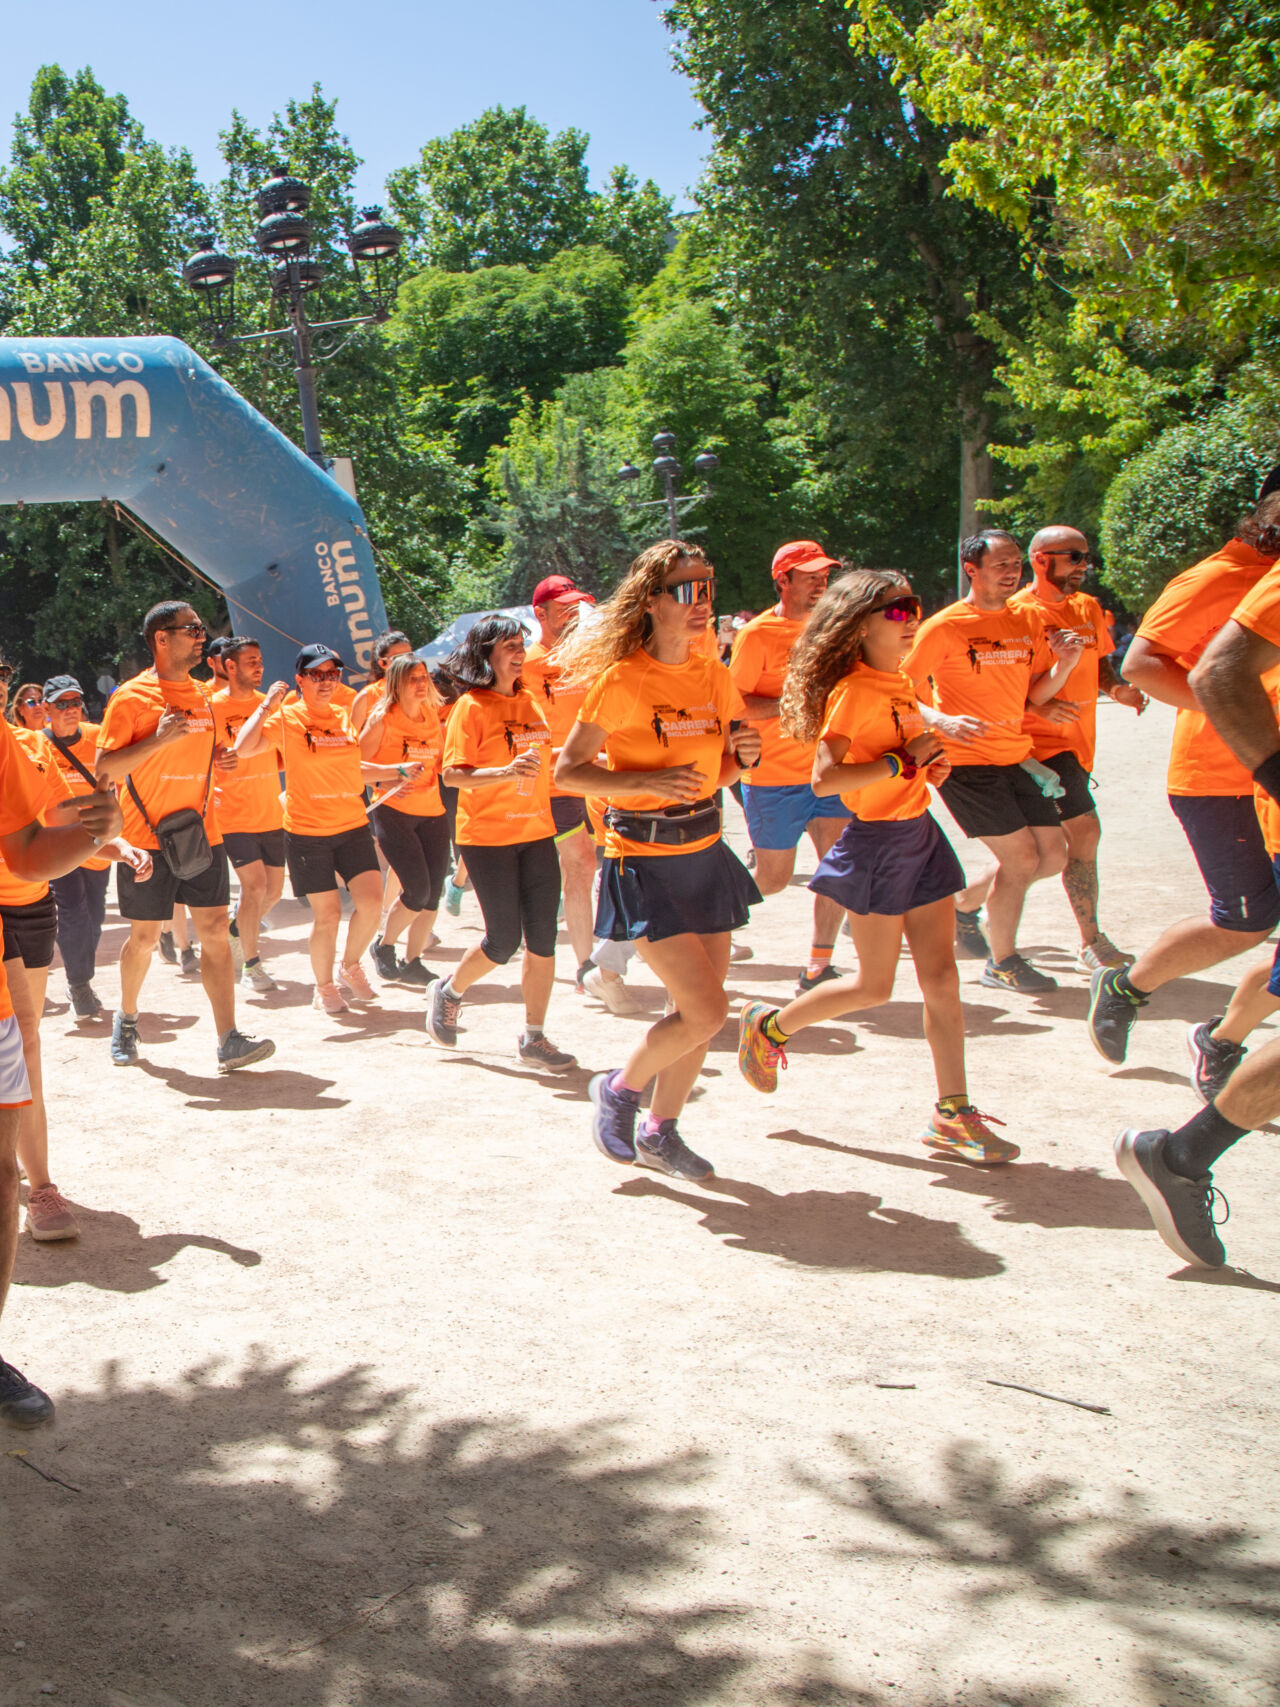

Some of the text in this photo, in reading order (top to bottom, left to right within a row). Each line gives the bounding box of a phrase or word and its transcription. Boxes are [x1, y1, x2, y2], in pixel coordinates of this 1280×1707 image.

[17, 352, 144, 374] BANCO
[315, 541, 340, 607] BANCO
[331, 540, 375, 686] lanum
